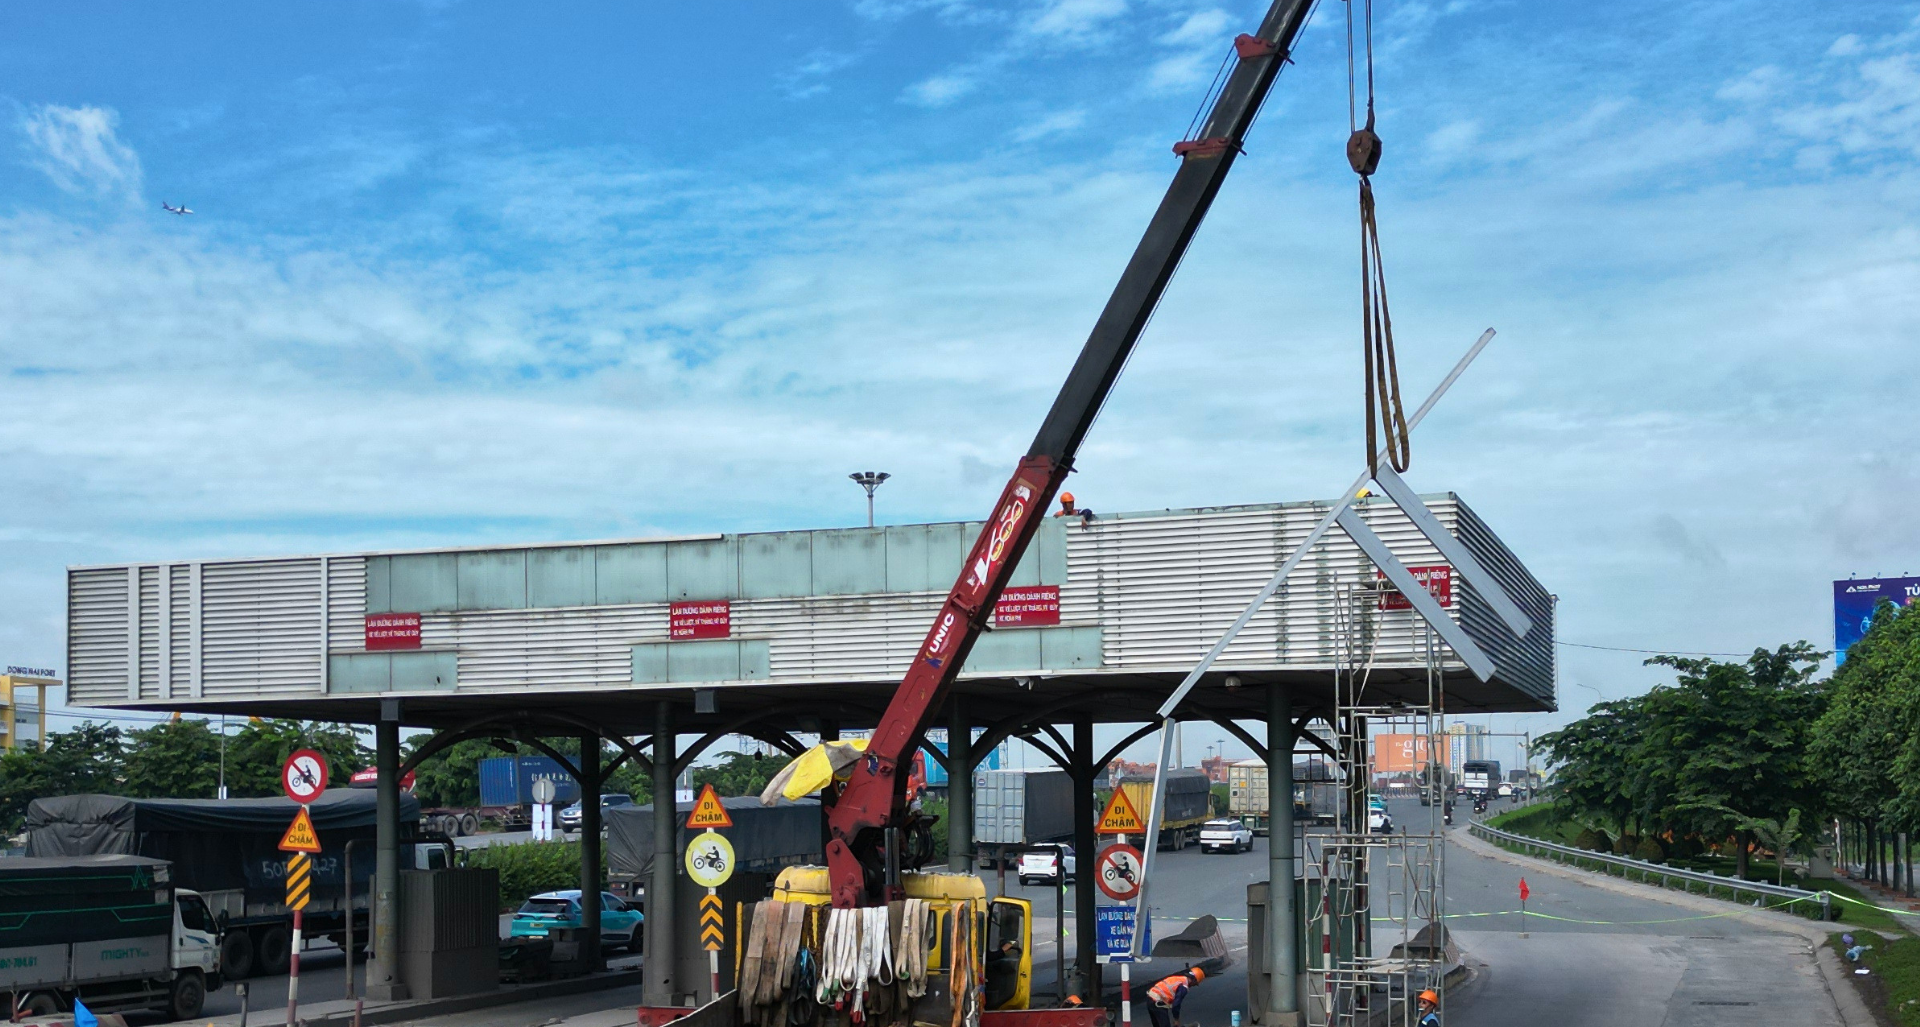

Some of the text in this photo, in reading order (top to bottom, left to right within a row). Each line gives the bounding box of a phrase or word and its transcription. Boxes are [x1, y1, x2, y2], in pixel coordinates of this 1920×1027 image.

[929, 613, 955, 653] UNIC
[704, 801, 714, 810] ĐI
[1114, 806, 1125, 815] ĐI
[695, 811, 723, 823] CHẬM
[1104, 817, 1135, 829] CHẬM
[297, 822, 307, 832] ĐI
[288, 834, 313, 847] CHẬM
[101, 948, 142, 961] MIGHTY
